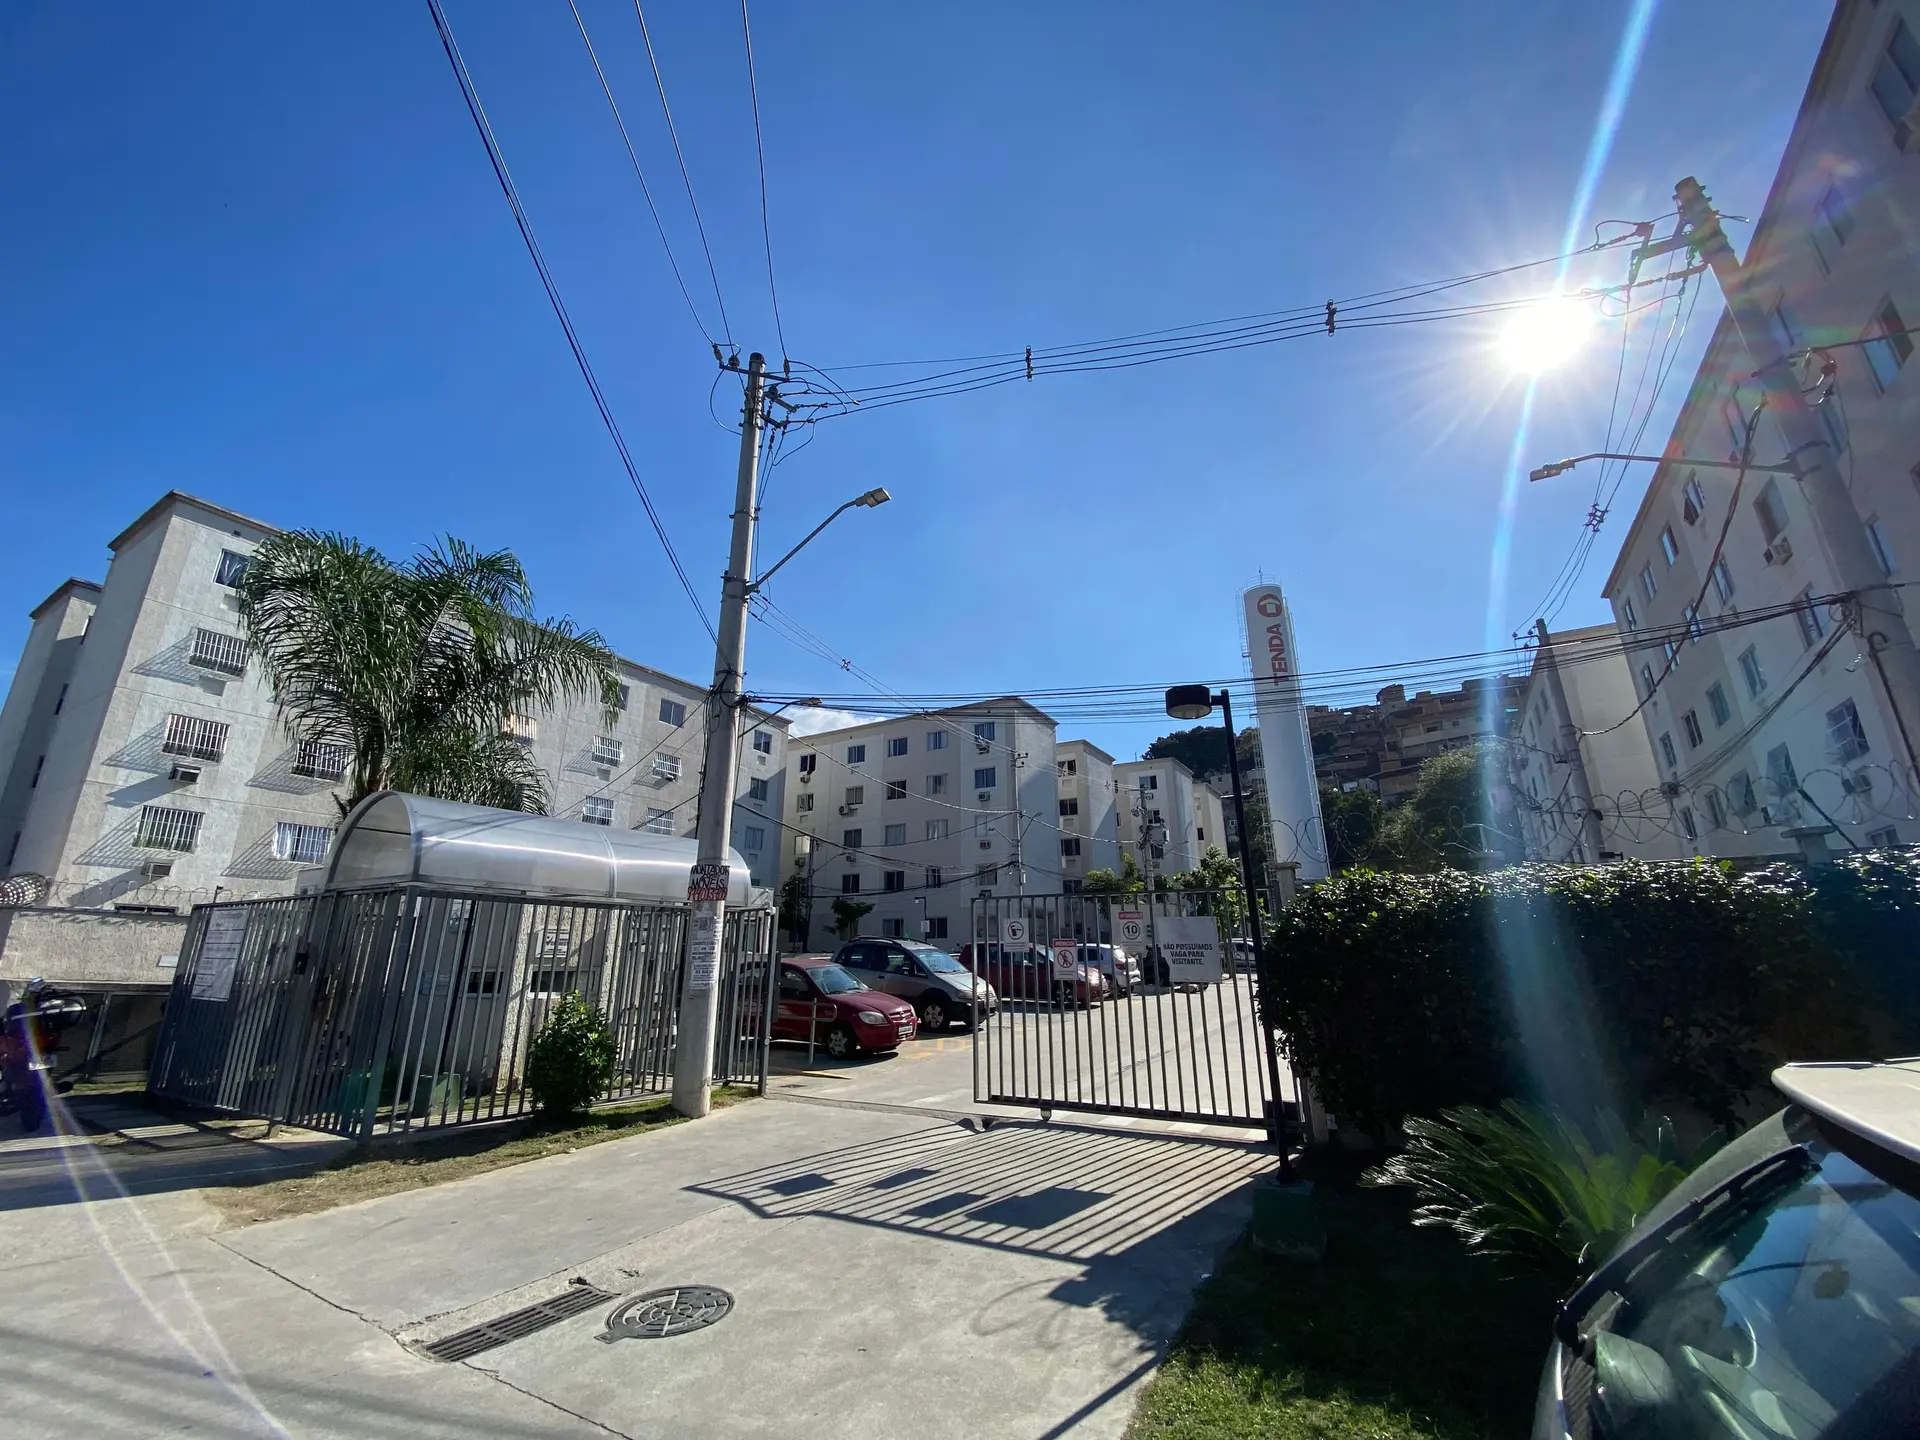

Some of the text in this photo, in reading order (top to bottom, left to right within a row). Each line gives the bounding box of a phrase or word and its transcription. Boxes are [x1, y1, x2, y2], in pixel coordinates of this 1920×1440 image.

[1266, 623, 1289, 686] TENDA
[690, 864, 730, 876] MONTADOR
[1125, 925, 1138, 934] 10
[1163, 942, 1175, 950] NÃO
